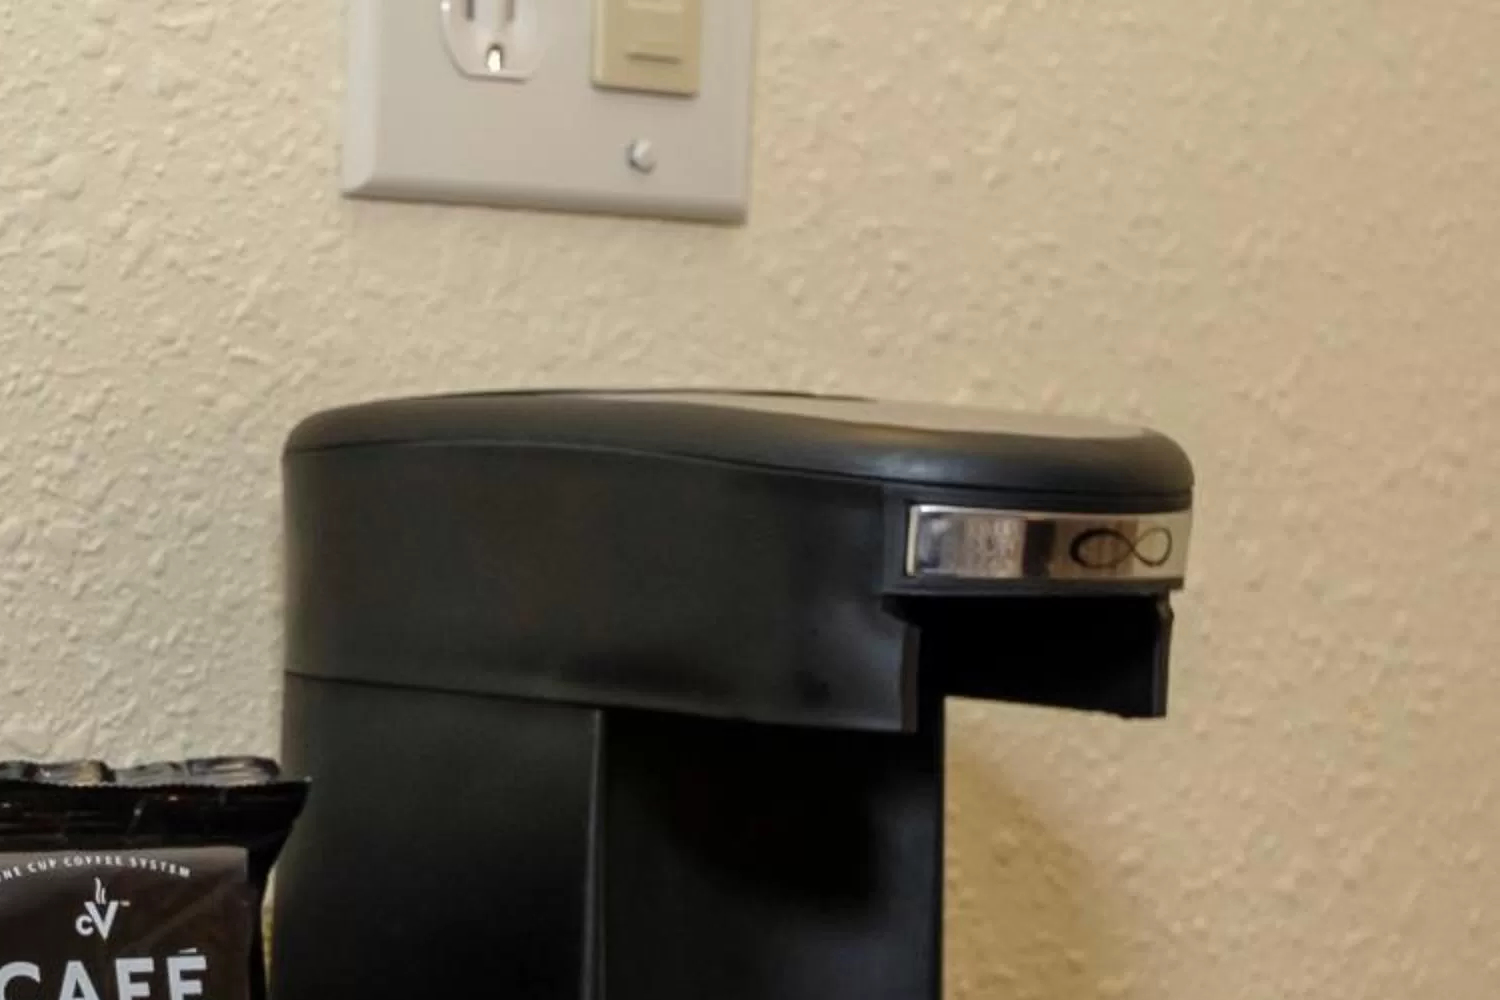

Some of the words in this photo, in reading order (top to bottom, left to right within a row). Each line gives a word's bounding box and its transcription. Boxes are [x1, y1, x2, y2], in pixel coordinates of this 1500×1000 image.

[26, 857, 57, 873] CUP
[63, 855, 123, 867] COFFEE
[128, 856, 192, 878] SYSTEM
